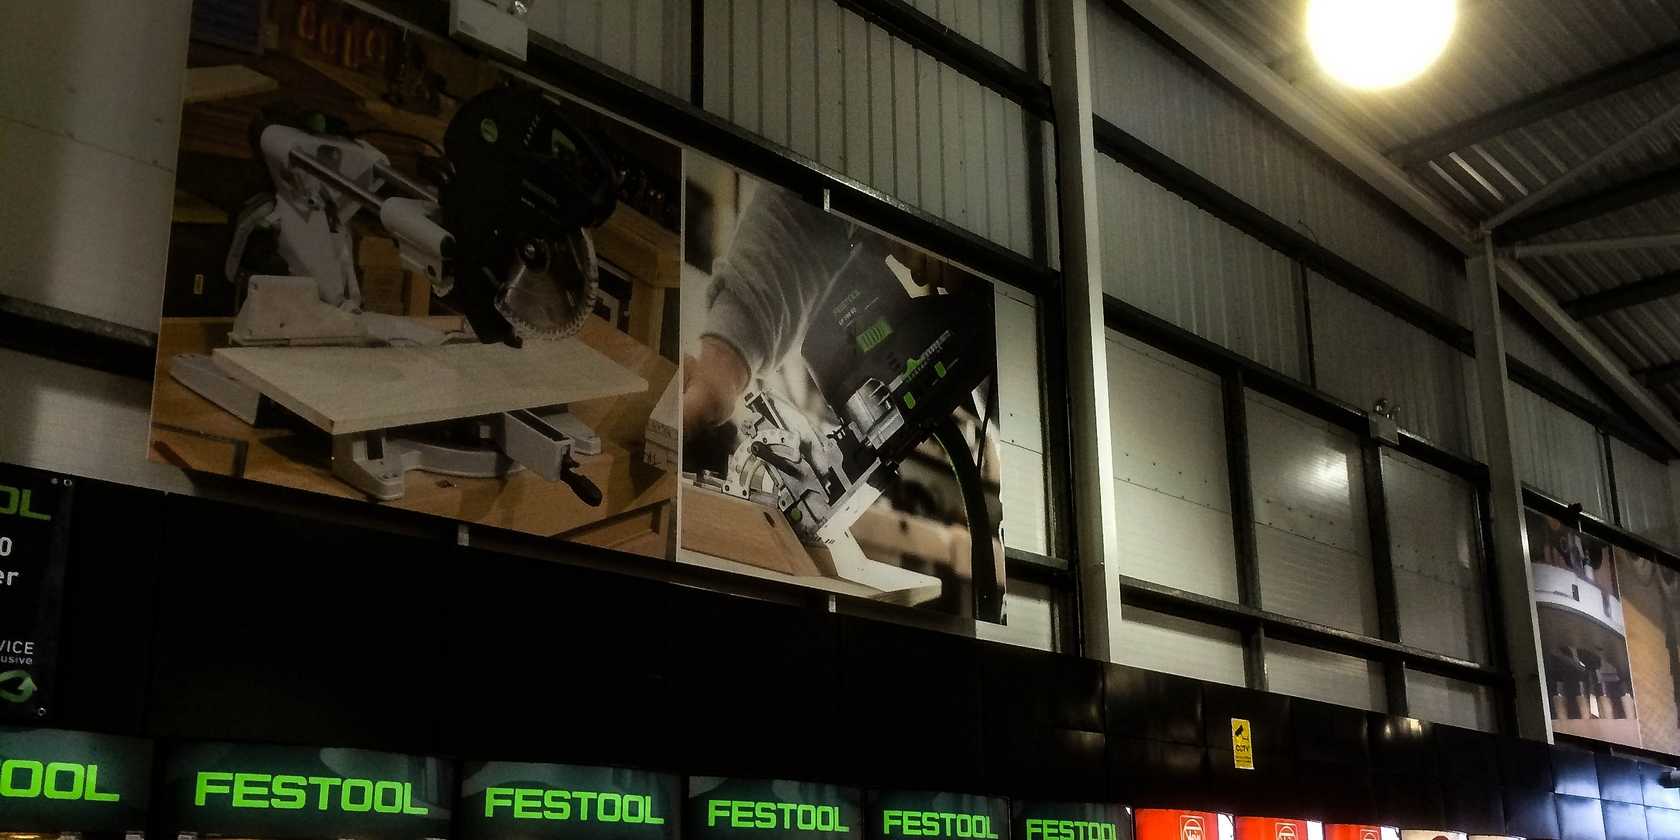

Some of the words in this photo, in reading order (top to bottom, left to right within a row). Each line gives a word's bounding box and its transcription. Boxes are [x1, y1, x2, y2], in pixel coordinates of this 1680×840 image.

[194, 771, 429, 815] FESTOOL
[484, 787, 665, 825] FESTOOL
[707, 799, 850, 833] FESTOOL
[883, 809, 999, 840] FESTOOL
